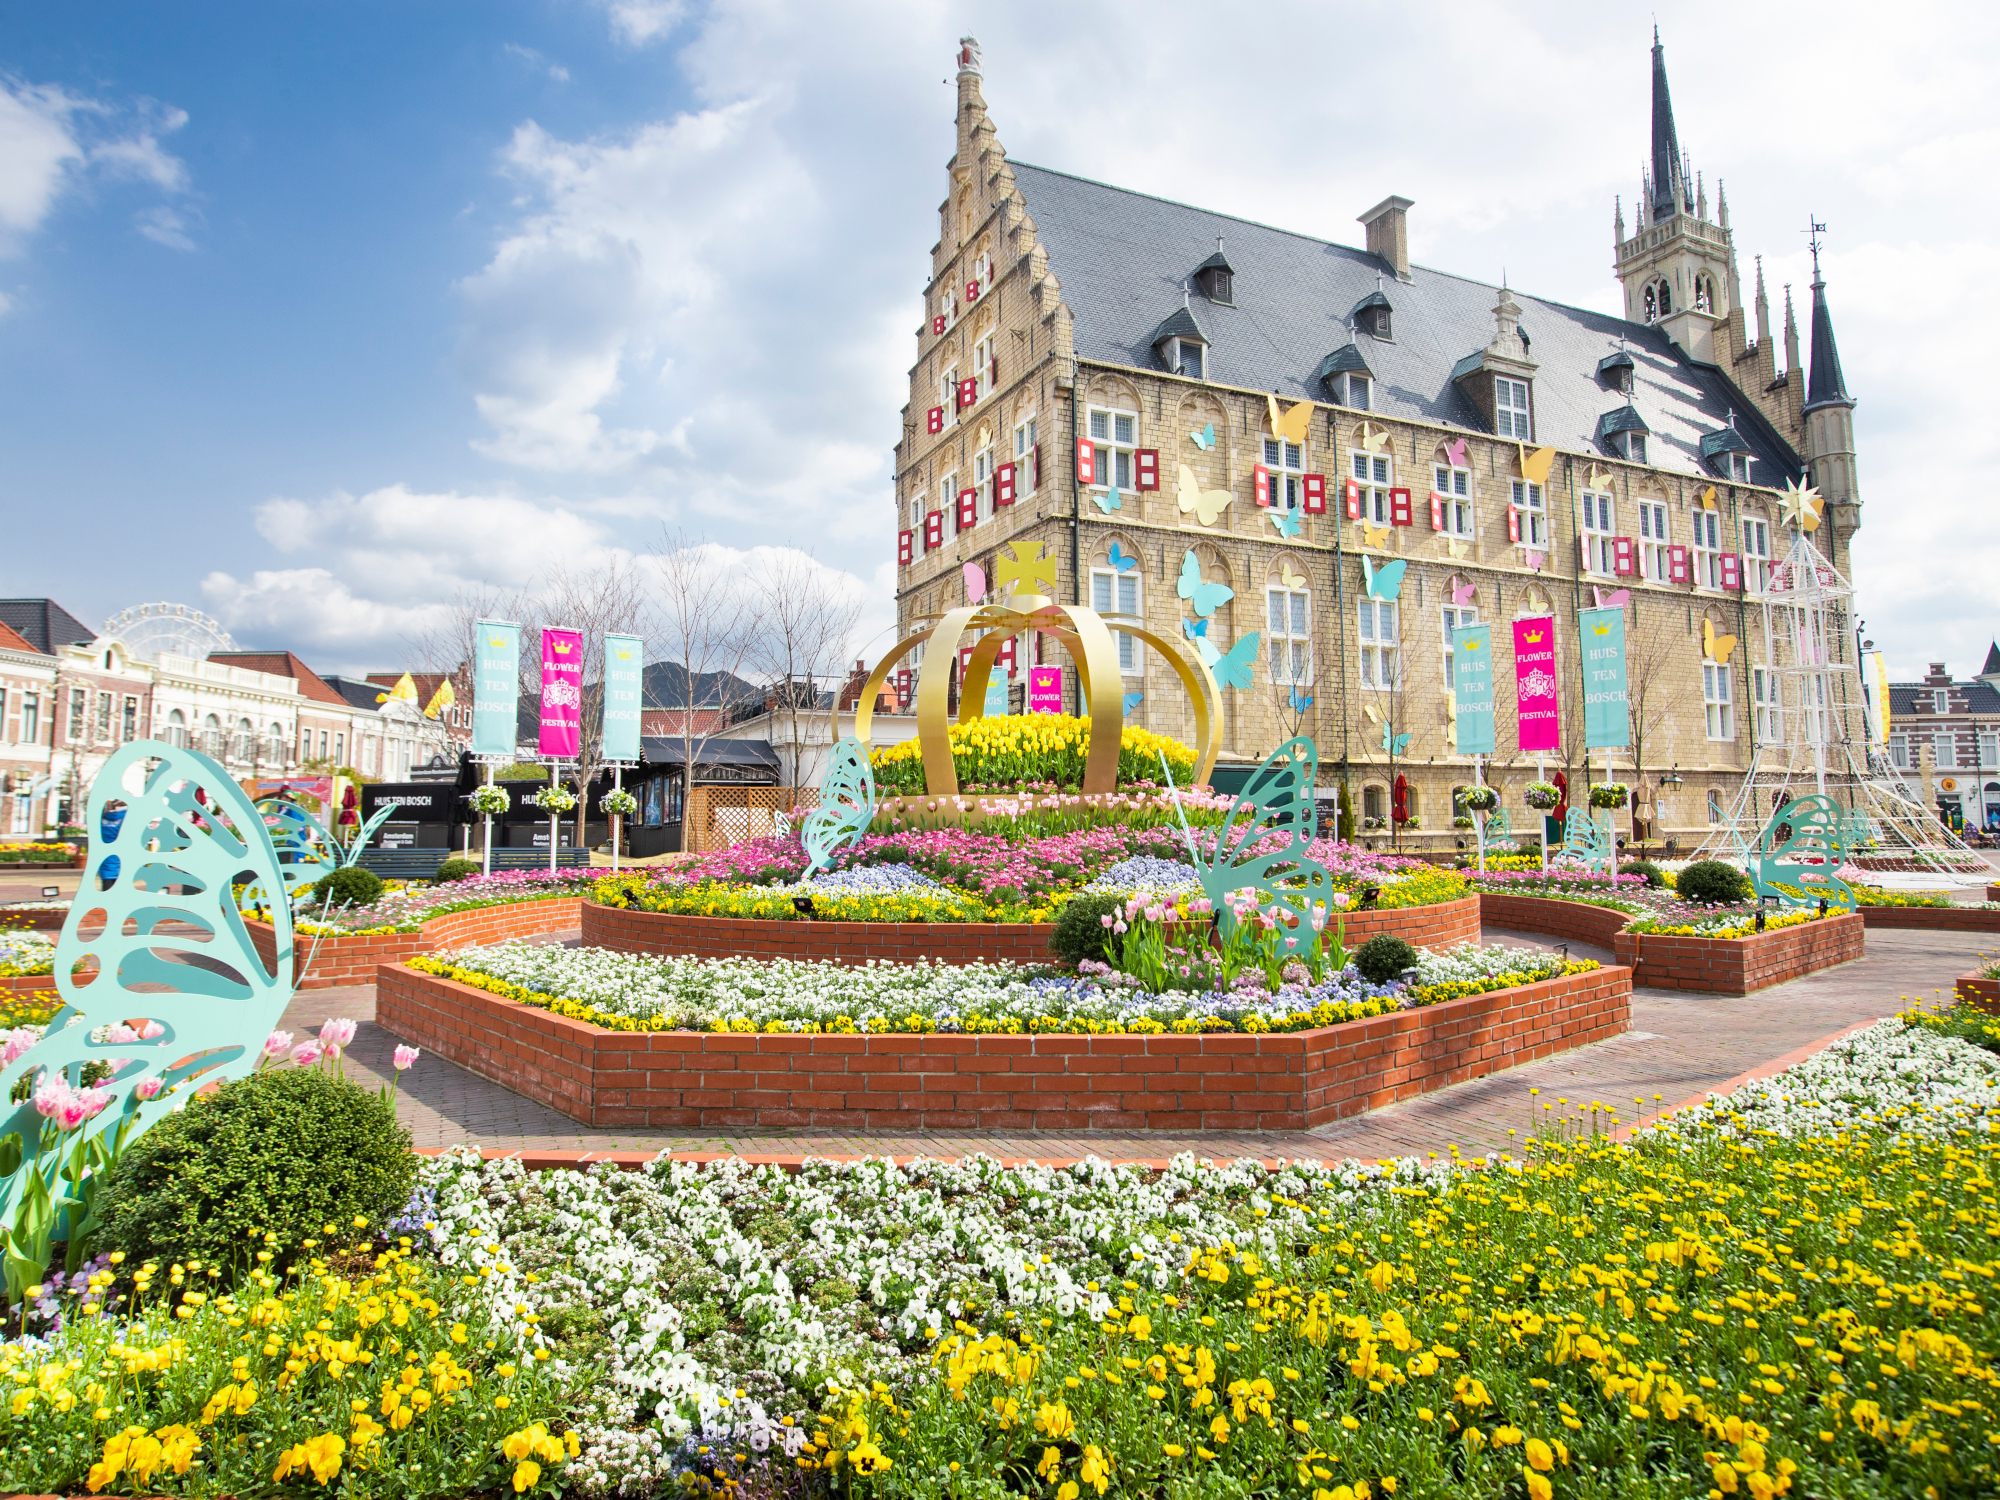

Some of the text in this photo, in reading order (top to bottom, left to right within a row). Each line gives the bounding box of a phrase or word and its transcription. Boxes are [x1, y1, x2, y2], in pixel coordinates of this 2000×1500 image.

[1517, 651, 1553, 663] FLOWER
[1589, 647, 1618, 660] HUIS
[483, 659, 512, 672] HUIS
[544, 662, 580, 673] FLOWER
[1460, 661, 1486, 673] HUIS
[611, 670, 637, 682] HUIS
[1592, 669, 1617, 682] TEN
[484, 680, 509, 692] TEN
[1463, 681, 1485, 693] TEN
[612, 690, 634, 701] TEN
[1585, 690, 1627, 704] BOSCH
[474, 701, 517, 713] BOSCH
[1456, 701, 1493, 714] BOSCH
[605, 709, 640, 721] BOSCH
[1519, 710, 1557, 720] FESTIVAL
[541, 718, 579, 728] FESTIVAL
[374, 796, 432, 806] HUIS TEN BOSCH
